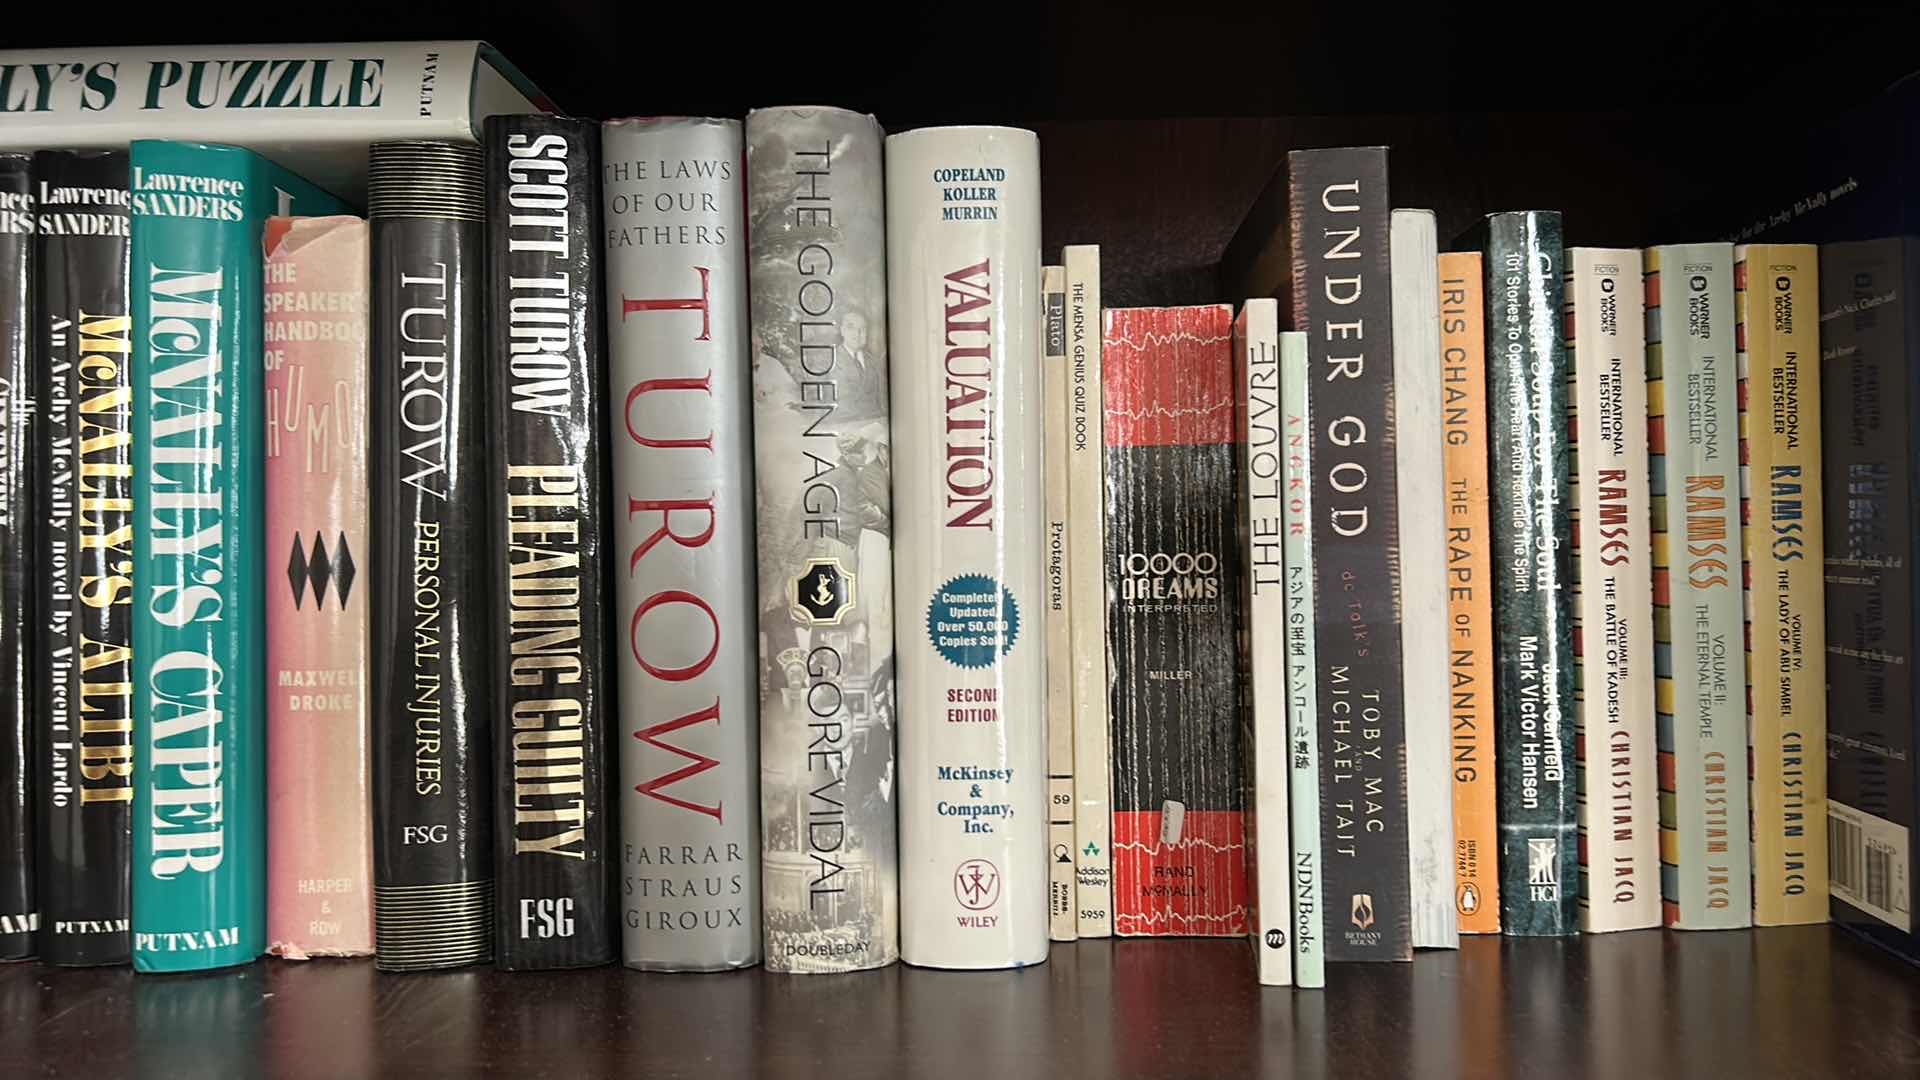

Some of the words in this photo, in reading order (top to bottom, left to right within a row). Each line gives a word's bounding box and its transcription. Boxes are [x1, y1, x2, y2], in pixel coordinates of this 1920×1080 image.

[141, 58, 385, 111] PUZZLE
[420, 53, 439, 116] PUTNAM
[134, 167, 244, 197] Lawrence
[660, 160, 731, 180] LAWS
[795, 140, 832, 228] THE
[933, 168, 1005, 183] COPELAND
[133, 193, 243, 222] SANDERS
[508, 134, 569, 260] SCOTT
[612, 194, 644, 214] OF
[655, 192, 718, 212] OUR
[942, 206, 998, 221] MURRIN
[943, 187, 996, 202] KOLLER
[39, 213, 131, 236] SANDER
[608, 225, 727, 248] FATHERS
[264, 262, 296, 284] THE
[1073, 283, 1083, 303] THE
[1322, 179, 1364, 383] UNDER
[1442, 279, 1466, 335] IRIS
[1506, 276, 1522, 323] Stories
[1601, 298, 1609, 332] BOOKS
[1608, 294, 1616, 336] WARNER
[1689, 297, 1700, 336] BOOKS
[1699, 292, 1710, 339] WARNER
[1775, 296, 1785, 331] BOOKS
[1783, 292, 1793, 335] WARNER
[51, 315, 72, 347] An
[798, 244, 840, 437] GOLDEN
[1050, 305, 1063, 346] Plato
[1074, 305, 1085, 342] MENSA
[1508, 325, 1522, 340] To
[264, 350, 285, 371] OF
[509, 271, 572, 420] TUROW
[1074, 346, 1085, 384] GENIUS
[48, 357, 72, 426] Archy
[400, 263, 448, 501] TUROW
[944, 258, 995, 532] VALUATION
[1075, 388, 1086, 413] QUIZ
[1444, 347, 1468, 446] CHANG
[1773, 367, 1785, 434] BESTSELLER
[1786, 352, 1799, 449] INTERNATIONAL
[266, 364, 353, 474] HUMO
[1250, 342, 1279, 500] LOUVRE
[1600, 374, 1611, 440] BESTSELLER
[1611, 358, 1624, 456] INTERNATIONAL
[1688, 373, 1701, 445] BESTSELLER
[1703, 356, 1718, 461] INTERNATIONAL
[1075, 417, 1087, 450] BOOK
[48, 436, 72, 531] McNally
[802, 450, 841, 541] AGE
[1287, 414, 1306, 536] ANGKOR
[1327, 415, 1369, 537] GOD
[1451, 478, 1467, 515] THE
[623, 265, 723, 826] TUROW
[1049, 521, 1063, 611] Protagoras
[1118, 553, 1218, 576] 10000
[1253, 517, 1280, 596] THE
[1449, 527, 1472, 602] RAPE
[52, 541, 72, 600] novel
[507, 463, 583, 686] PLEADING
[1122, 577, 1218, 600] DREAMS
[1512, 559, 1531, 592] Spirit
[1604, 576, 1616, 599] THE
[1778, 569, 1789, 590] THE
[414, 521, 441, 667] PERSONAL
[1778, 595, 1790, 623] LADY
[49, 611, 72, 637] by
[937, 620, 966, 632] Over
[967, 620, 1009, 633] 50,00
[1455, 614, 1471, 638] OF
[1605, 604, 1618, 646] BATTLE
[1696, 604, 1709, 627] THE
[1779, 628, 1790, 645] OF
[1792, 614, 1801, 655] VOLUME
[940, 635, 978, 648] Copies
[1519, 636, 1538, 680] Mark
[1606, 650, 1618, 668] OF
[1618, 618, 1628, 664] VOLUME
[1696, 632, 1711, 688] ETERNAL
[1780, 649, 1791, 673] ABU
[1150, 671, 1193, 680] MILLER
[1712, 634, 1727, 691] VOLUME
[52, 647, 72, 731] Vincent
[289, 694, 352, 711] DROKE
[806, 646, 844, 771] GORE
[947, 688, 998, 702] SECON
[1607, 671, 1620, 723] KADESH
[1780, 676, 1792, 717] SIMBEL
[79, 633, 132, 806] ALIBI
[1331, 665, 1354, 783] MICHAEL
[1361, 690, 1382, 760] TOBY
[1451, 650, 1477, 783] NANKING
[1521, 685, 1540, 738] Victor
[1699, 691, 1713, 738] TEMPLE
[407, 674, 441, 796] INJURIES
[52, 743, 72, 807] Lardo
[150, 651, 225, 880] CAPER
[511, 698, 585, 861] GUILTY
[938, 766, 1014, 783] McKinsey
[1522, 743, 1541, 809] Hansen
[1611, 730, 1633, 841] CHRISTIAN
[1783, 732, 1803, 837] CHRISTIAN
[938, 801, 1014, 819] Company,
[969, 784, 983, 798] &
[1053, 794, 1070, 805] 59
[1704, 751, 1728, 852] CHRISTIAN
[403, 825, 448, 845] FSG
[808, 777, 846, 910] VIDAL
[964, 820, 994, 833] Inc.
[1336, 799, 1357, 857] TAIT
[625, 843, 744, 865] FARRAR
[1154, 866, 1195, 878] RAND
[1784, 852, 1805, 896] JACQ
[298, 879, 352, 894] HARPER
[625, 875, 742, 897] STRAUS
[1530, 886, 1559, 902] HCI
[1613, 857, 1635, 903] JACQ
[1706, 866, 1729, 909] JACQ
[309, 919, 342, 936] ROW
[320, 902, 331, 915] &
[520, 897, 575, 939] FSG
[626, 908, 743, 930] GIROUX
[957, 916, 998, 928] WILEY
[1080, 910, 1106, 919] 5959
[135, 927, 240, 952] PUTNAM
[786, 940, 871, 957] DOUBLEDAY
